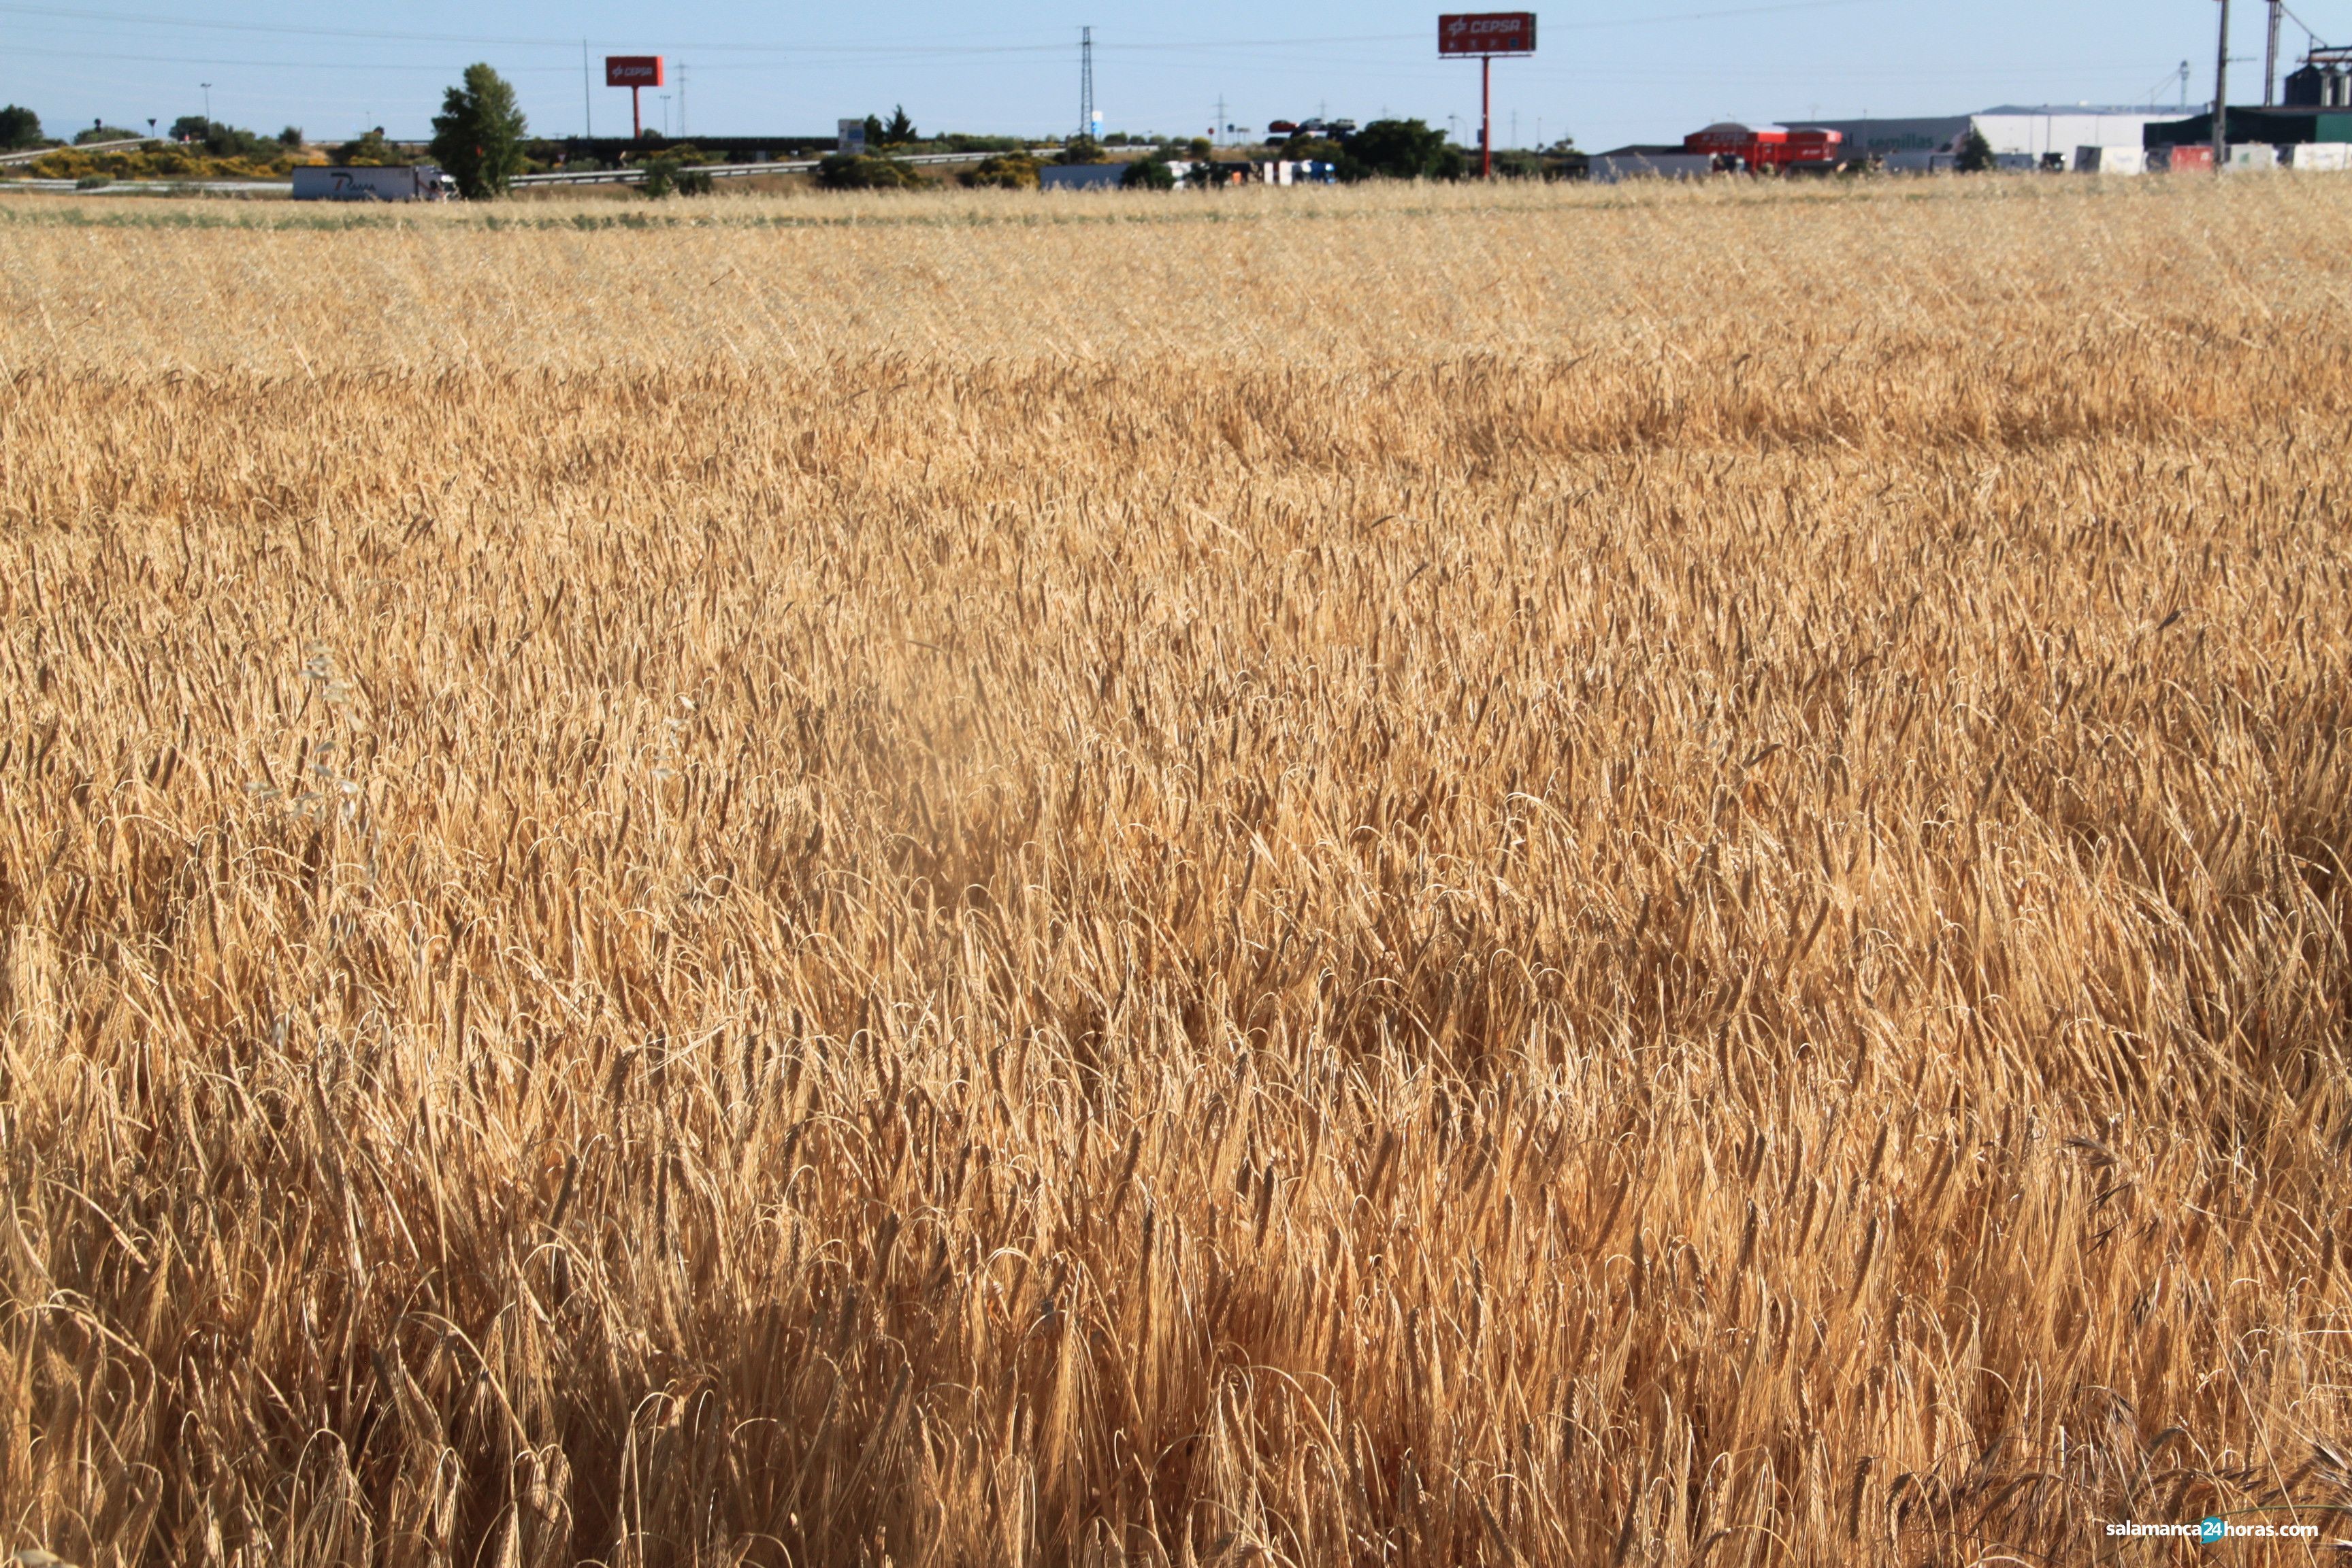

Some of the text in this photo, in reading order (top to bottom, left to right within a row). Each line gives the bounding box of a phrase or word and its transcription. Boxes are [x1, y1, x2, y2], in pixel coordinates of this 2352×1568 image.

[1470, 19, 1522, 33] CEPSA
[624, 67, 653, 76] CEPSA
[1867, 133, 1933, 149] semillas
